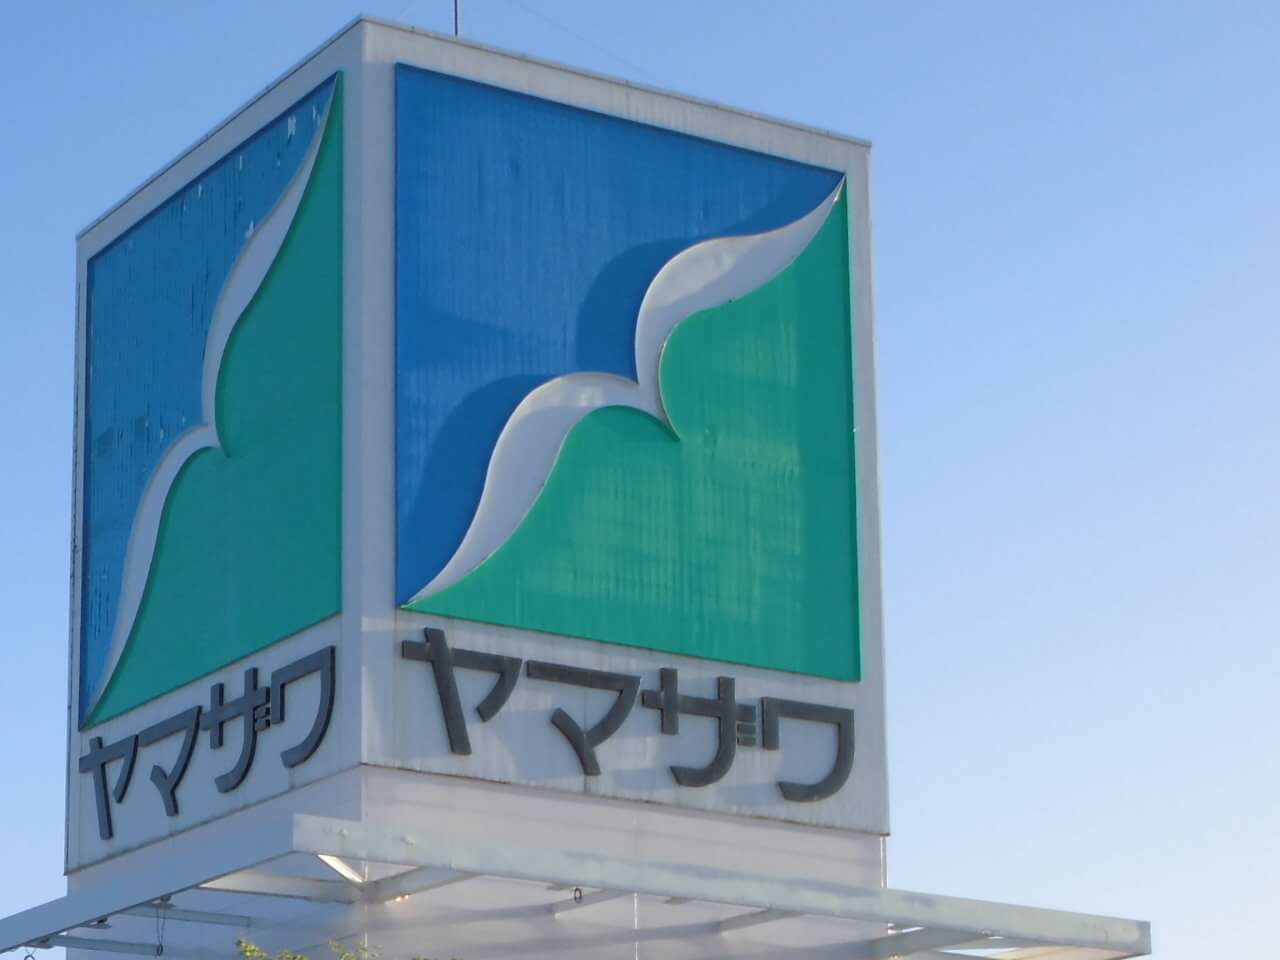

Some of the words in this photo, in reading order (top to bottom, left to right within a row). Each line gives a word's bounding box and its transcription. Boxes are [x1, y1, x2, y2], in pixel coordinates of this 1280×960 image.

[78, 644, 337, 842] ヤマザワ
[401, 626, 856, 803] ヤマザワ
